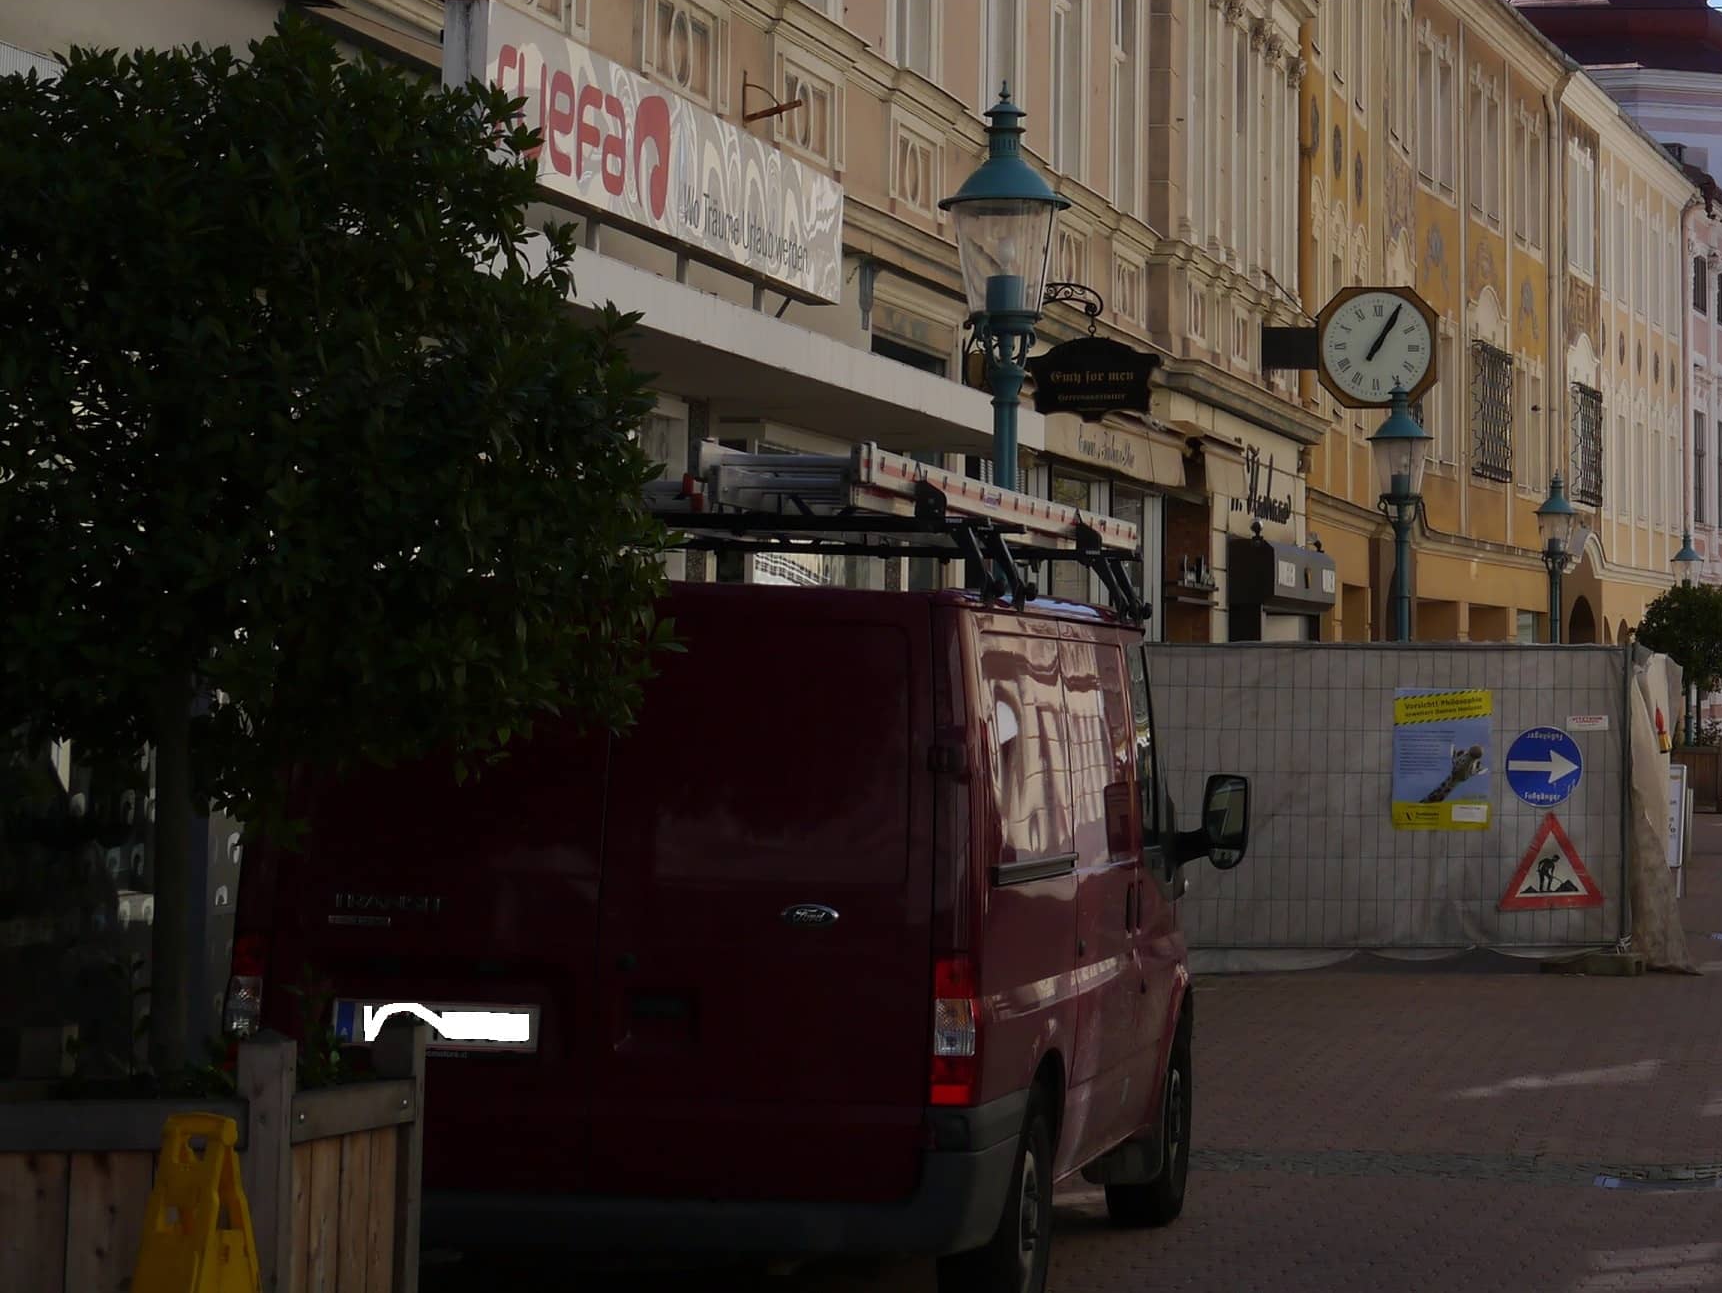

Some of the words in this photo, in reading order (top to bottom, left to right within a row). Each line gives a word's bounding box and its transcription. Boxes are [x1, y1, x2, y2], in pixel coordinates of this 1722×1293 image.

[495, 44, 626, 196] ruefa
[684, 185, 700, 229] Wo
[703, 192, 740, 246] Träume
[742, 209, 775, 260] Urlaub
[1085, 371, 1105, 384] for
[1108, 371, 1134, 381] men
[793, 908, 826, 924] Ford
